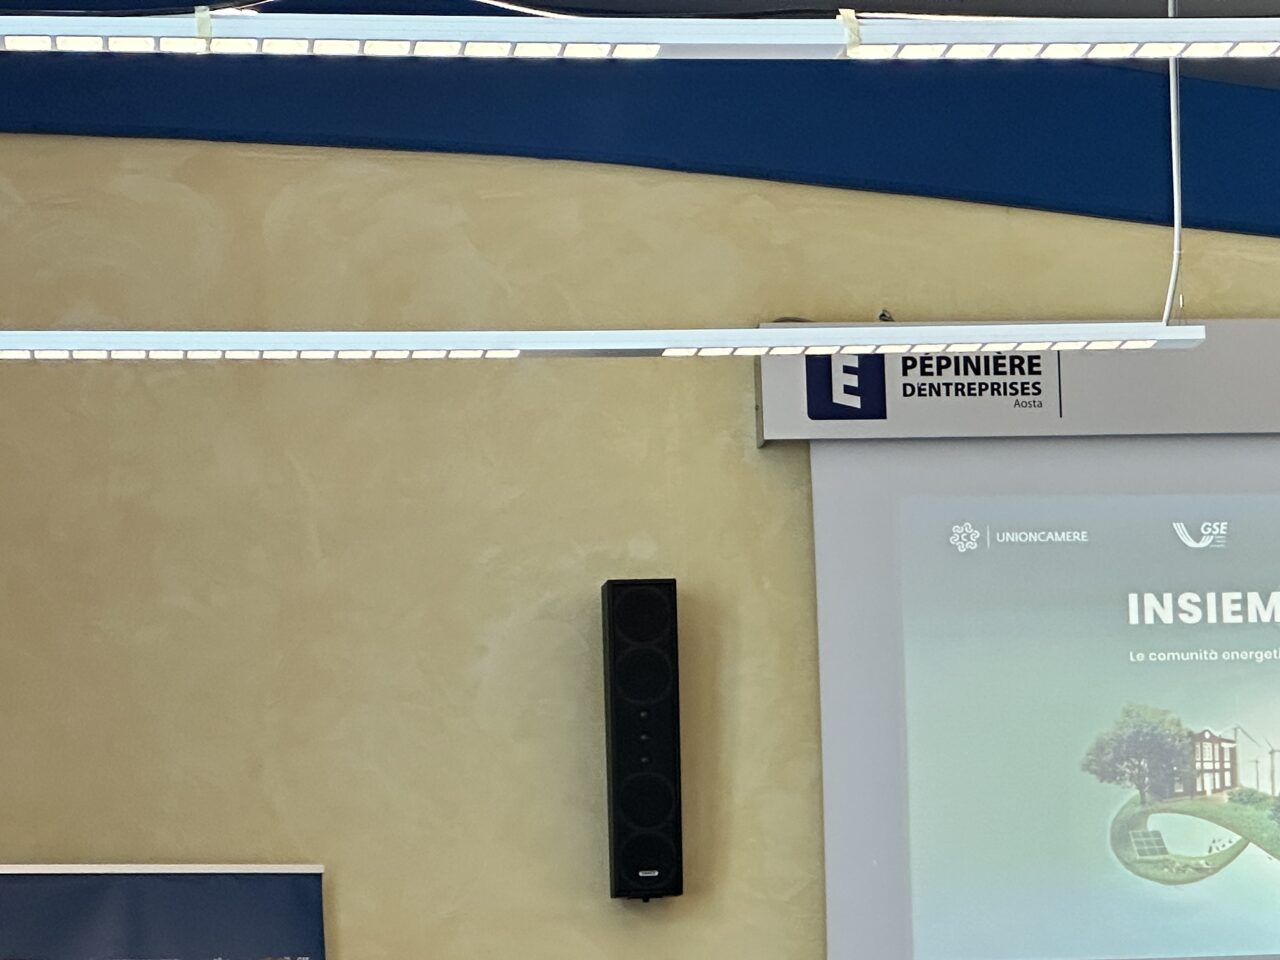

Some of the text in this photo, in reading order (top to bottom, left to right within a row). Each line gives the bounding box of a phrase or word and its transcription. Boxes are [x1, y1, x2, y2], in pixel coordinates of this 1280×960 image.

[901, 352, 1042, 377] PÉPINIÈRE
[1013, 399, 1043, 409] Aosta
[1200, 521, 1228, 535] GSE
[996, 530, 1089, 543] UNIONCAMERE
[1129, 651, 1145, 662] Le
[1148, 648, 1218, 662] comunità
